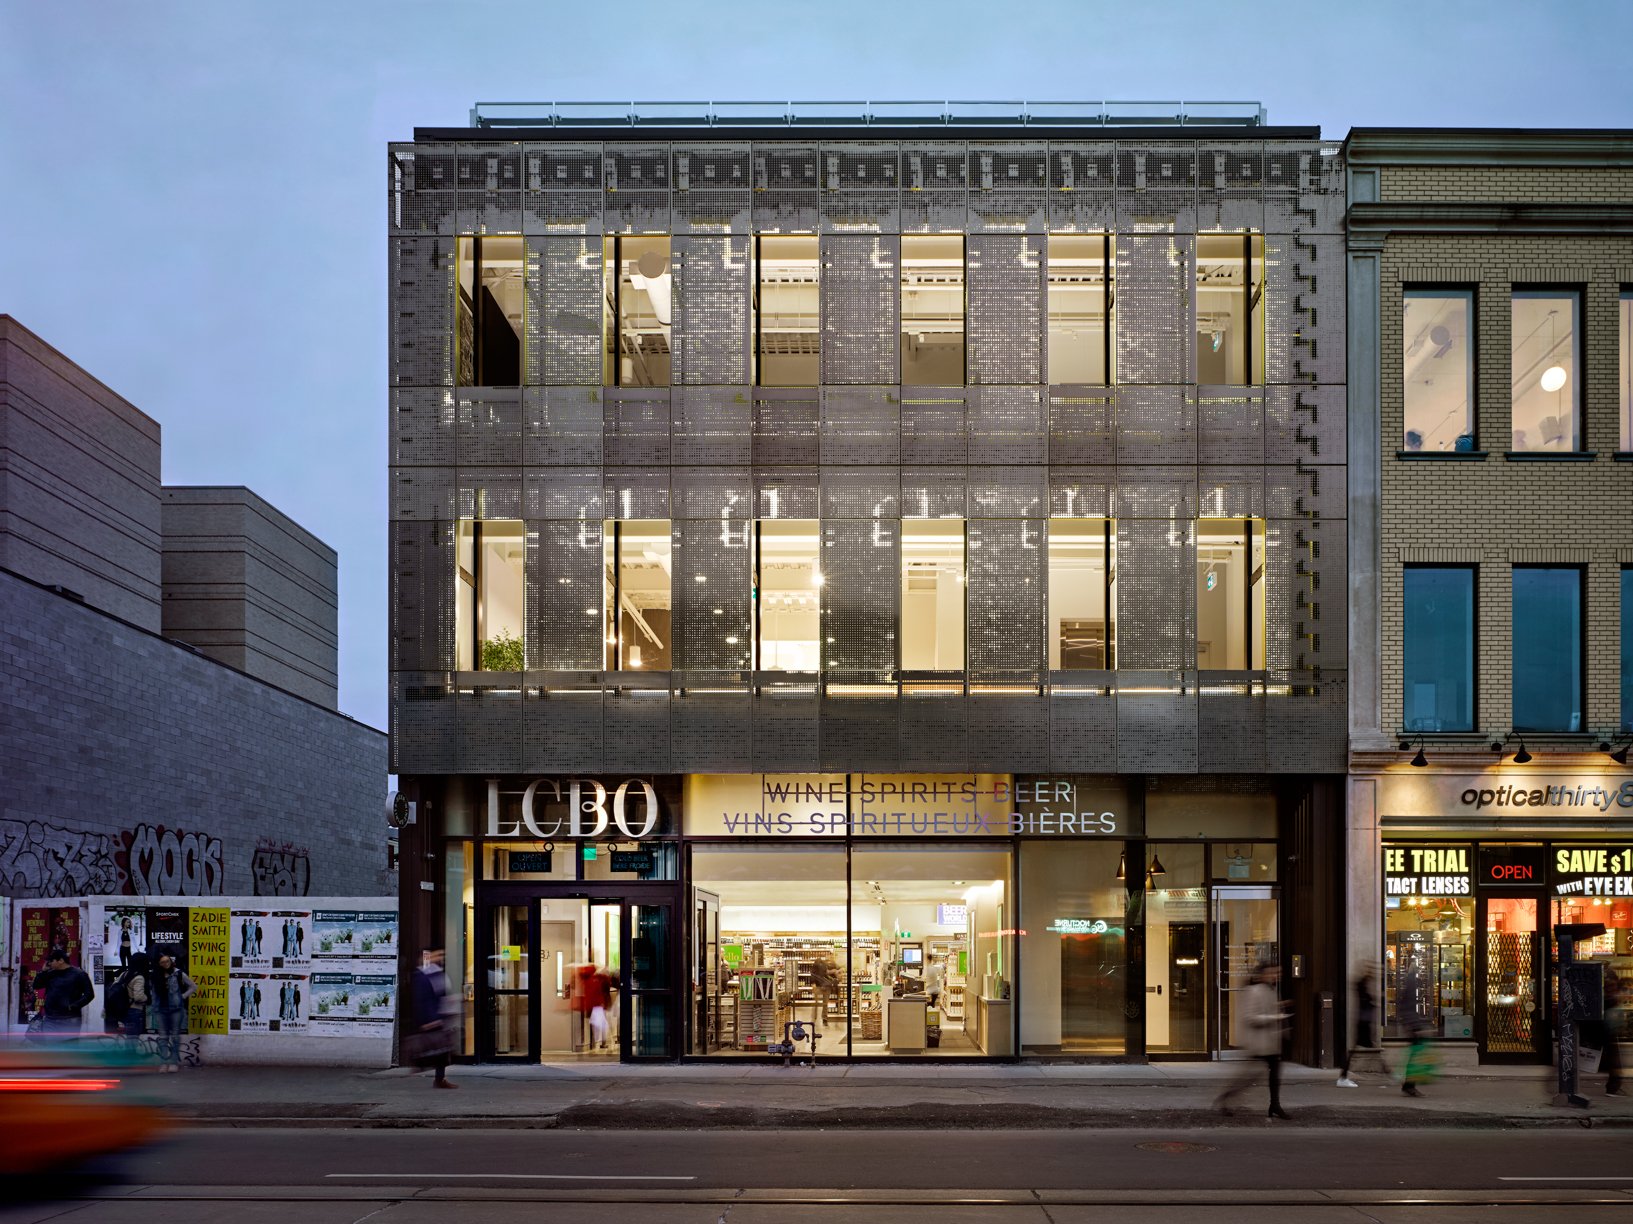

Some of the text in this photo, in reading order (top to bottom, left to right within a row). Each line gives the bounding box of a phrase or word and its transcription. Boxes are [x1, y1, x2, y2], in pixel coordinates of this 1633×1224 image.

[766, 782, 1071, 803] WINE SPIRITS BEER
[485, 778, 658, 838] LCBO
[723, 807, 1117, 834] VINS SPIRITUEUX BIÈRES
[511, 862, 548, 870] OUVERT
[1411, 849, 1469, 873] TRIAL
[1557, 848, 1633, 875] SAVE $1
[1491, 865, 1532, 879] OPEN
[1387, 876, 1469, 895] TACT LENSES
[1556, 880, 1583, 895] WITH
[1584, 876, 1613, 895] EYE
[192, 912, 227, 923] ZADIE
[151, 932, 184, 940] LIFESTYLE
[192, 925, 226, 936] SMITH
[192, 942, 226, 953] SWING
[192, 955, 226, 966] TIME
[724, 952, 739, 961] ello
[192, 975, 226, 986] ZADIE
[191, 988, 225, 999] SMITH
[191, 1005, 225, 1016] SWING
[191, 1018, 224, 1029] TIME
